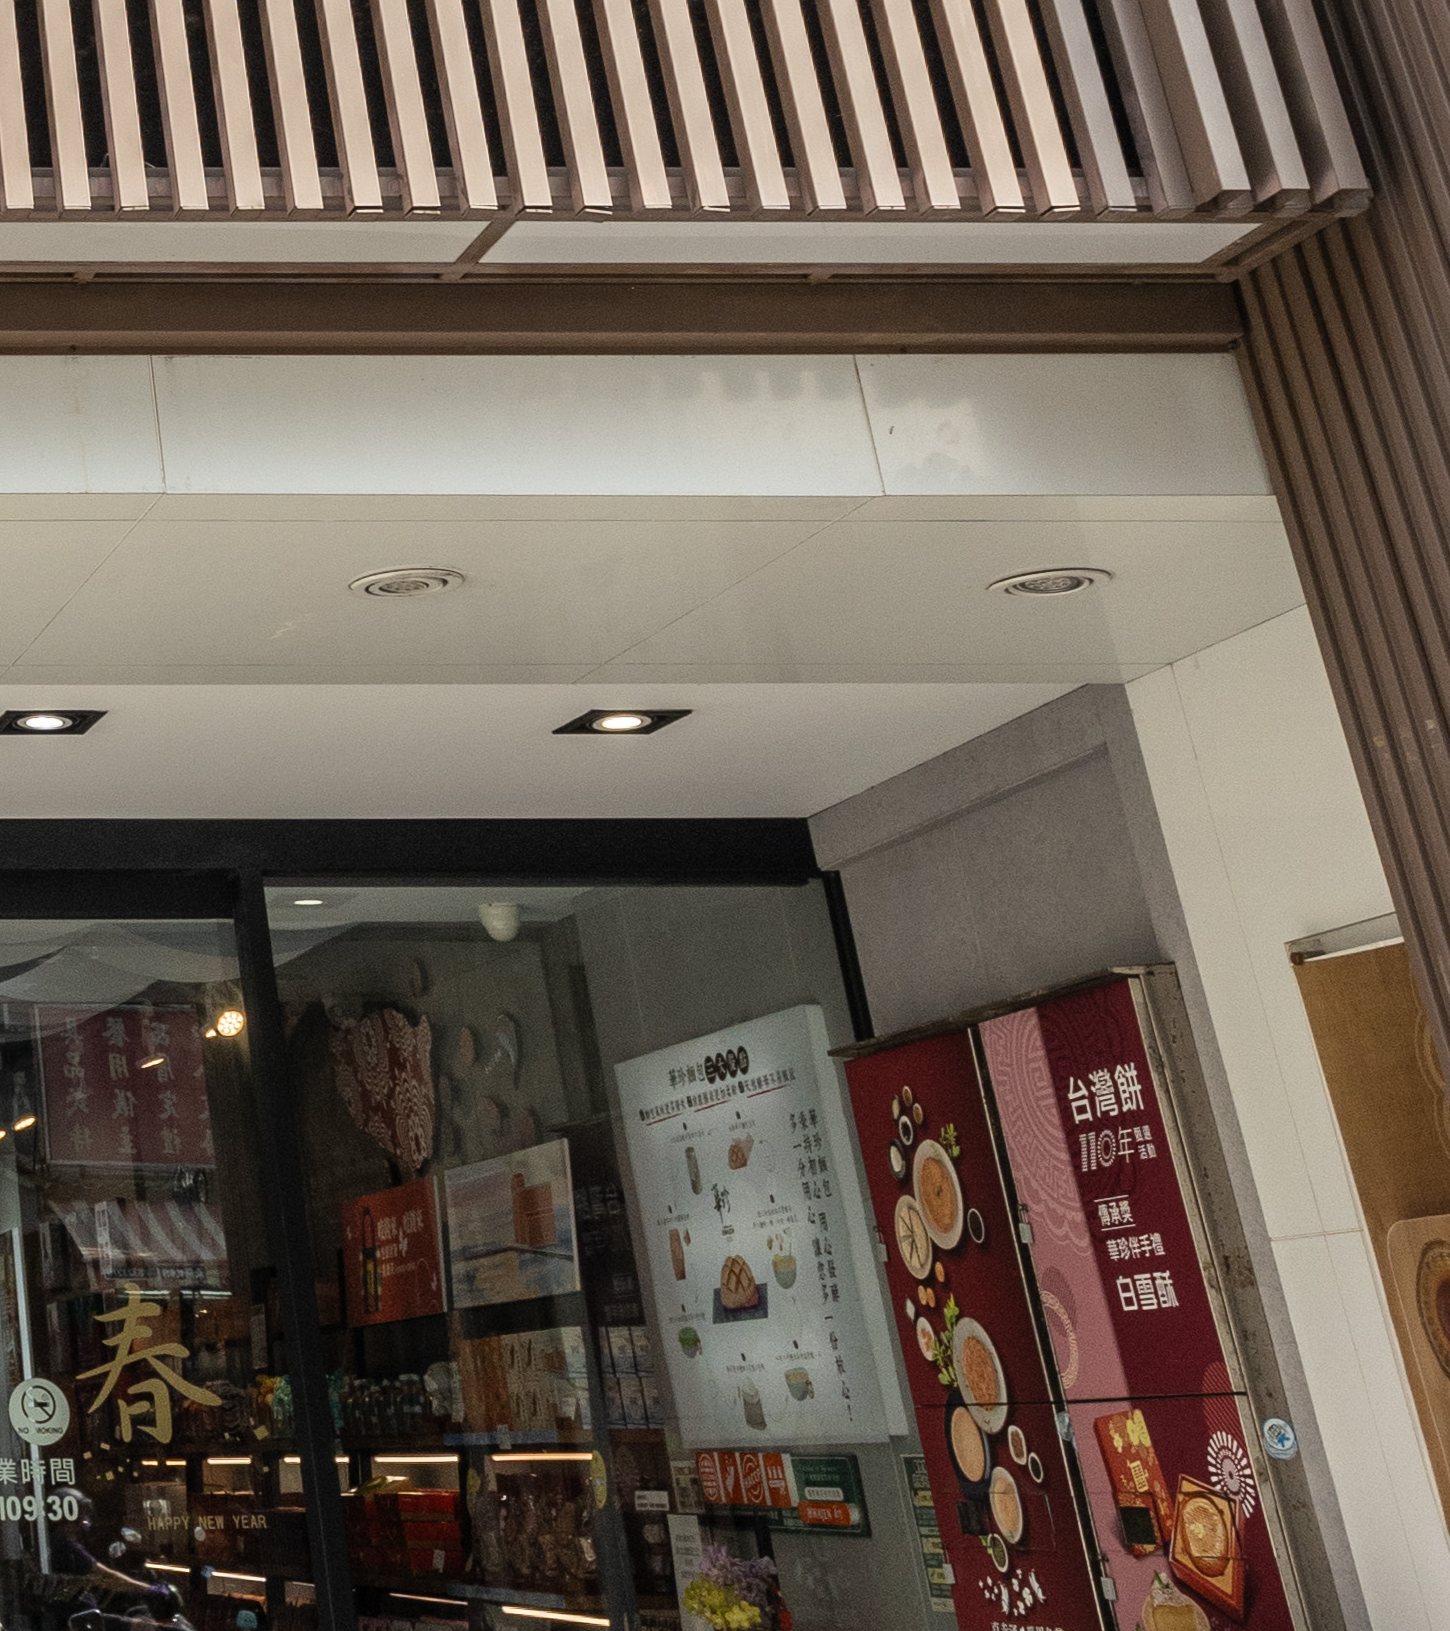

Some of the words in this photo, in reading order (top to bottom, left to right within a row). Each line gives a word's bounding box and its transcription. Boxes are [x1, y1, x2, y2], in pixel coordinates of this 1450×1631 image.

[1067, 1062, 1144, 1124] 台灣餅
[75, 1282, 222, 1444] 春
[147, 1516, 190, 1530] HAPPY
[199, 1515, 224, 1530] NEW
[232, 1514, 268, 1529] YEAR
